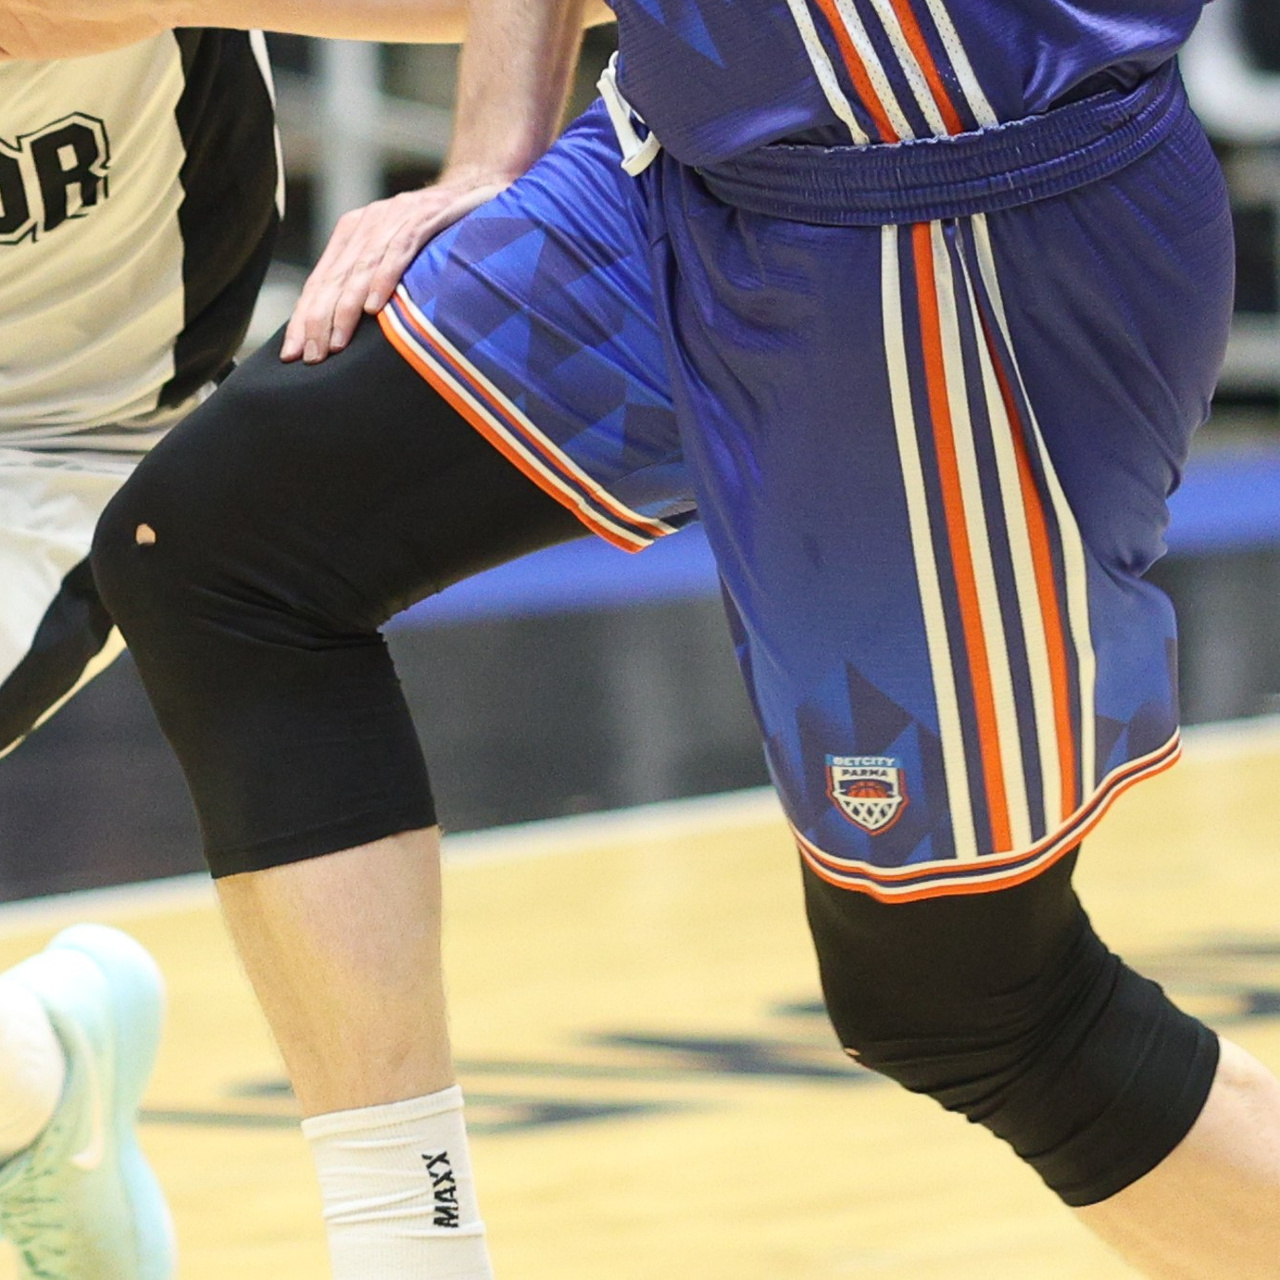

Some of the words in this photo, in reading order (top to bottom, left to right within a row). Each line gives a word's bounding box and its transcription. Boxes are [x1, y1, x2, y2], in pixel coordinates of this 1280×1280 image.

[832, 756, 896, 767] BETCITY
[841, 768, 888, 777] PARMA
[421, 1150, 459, 1228] MAXX
